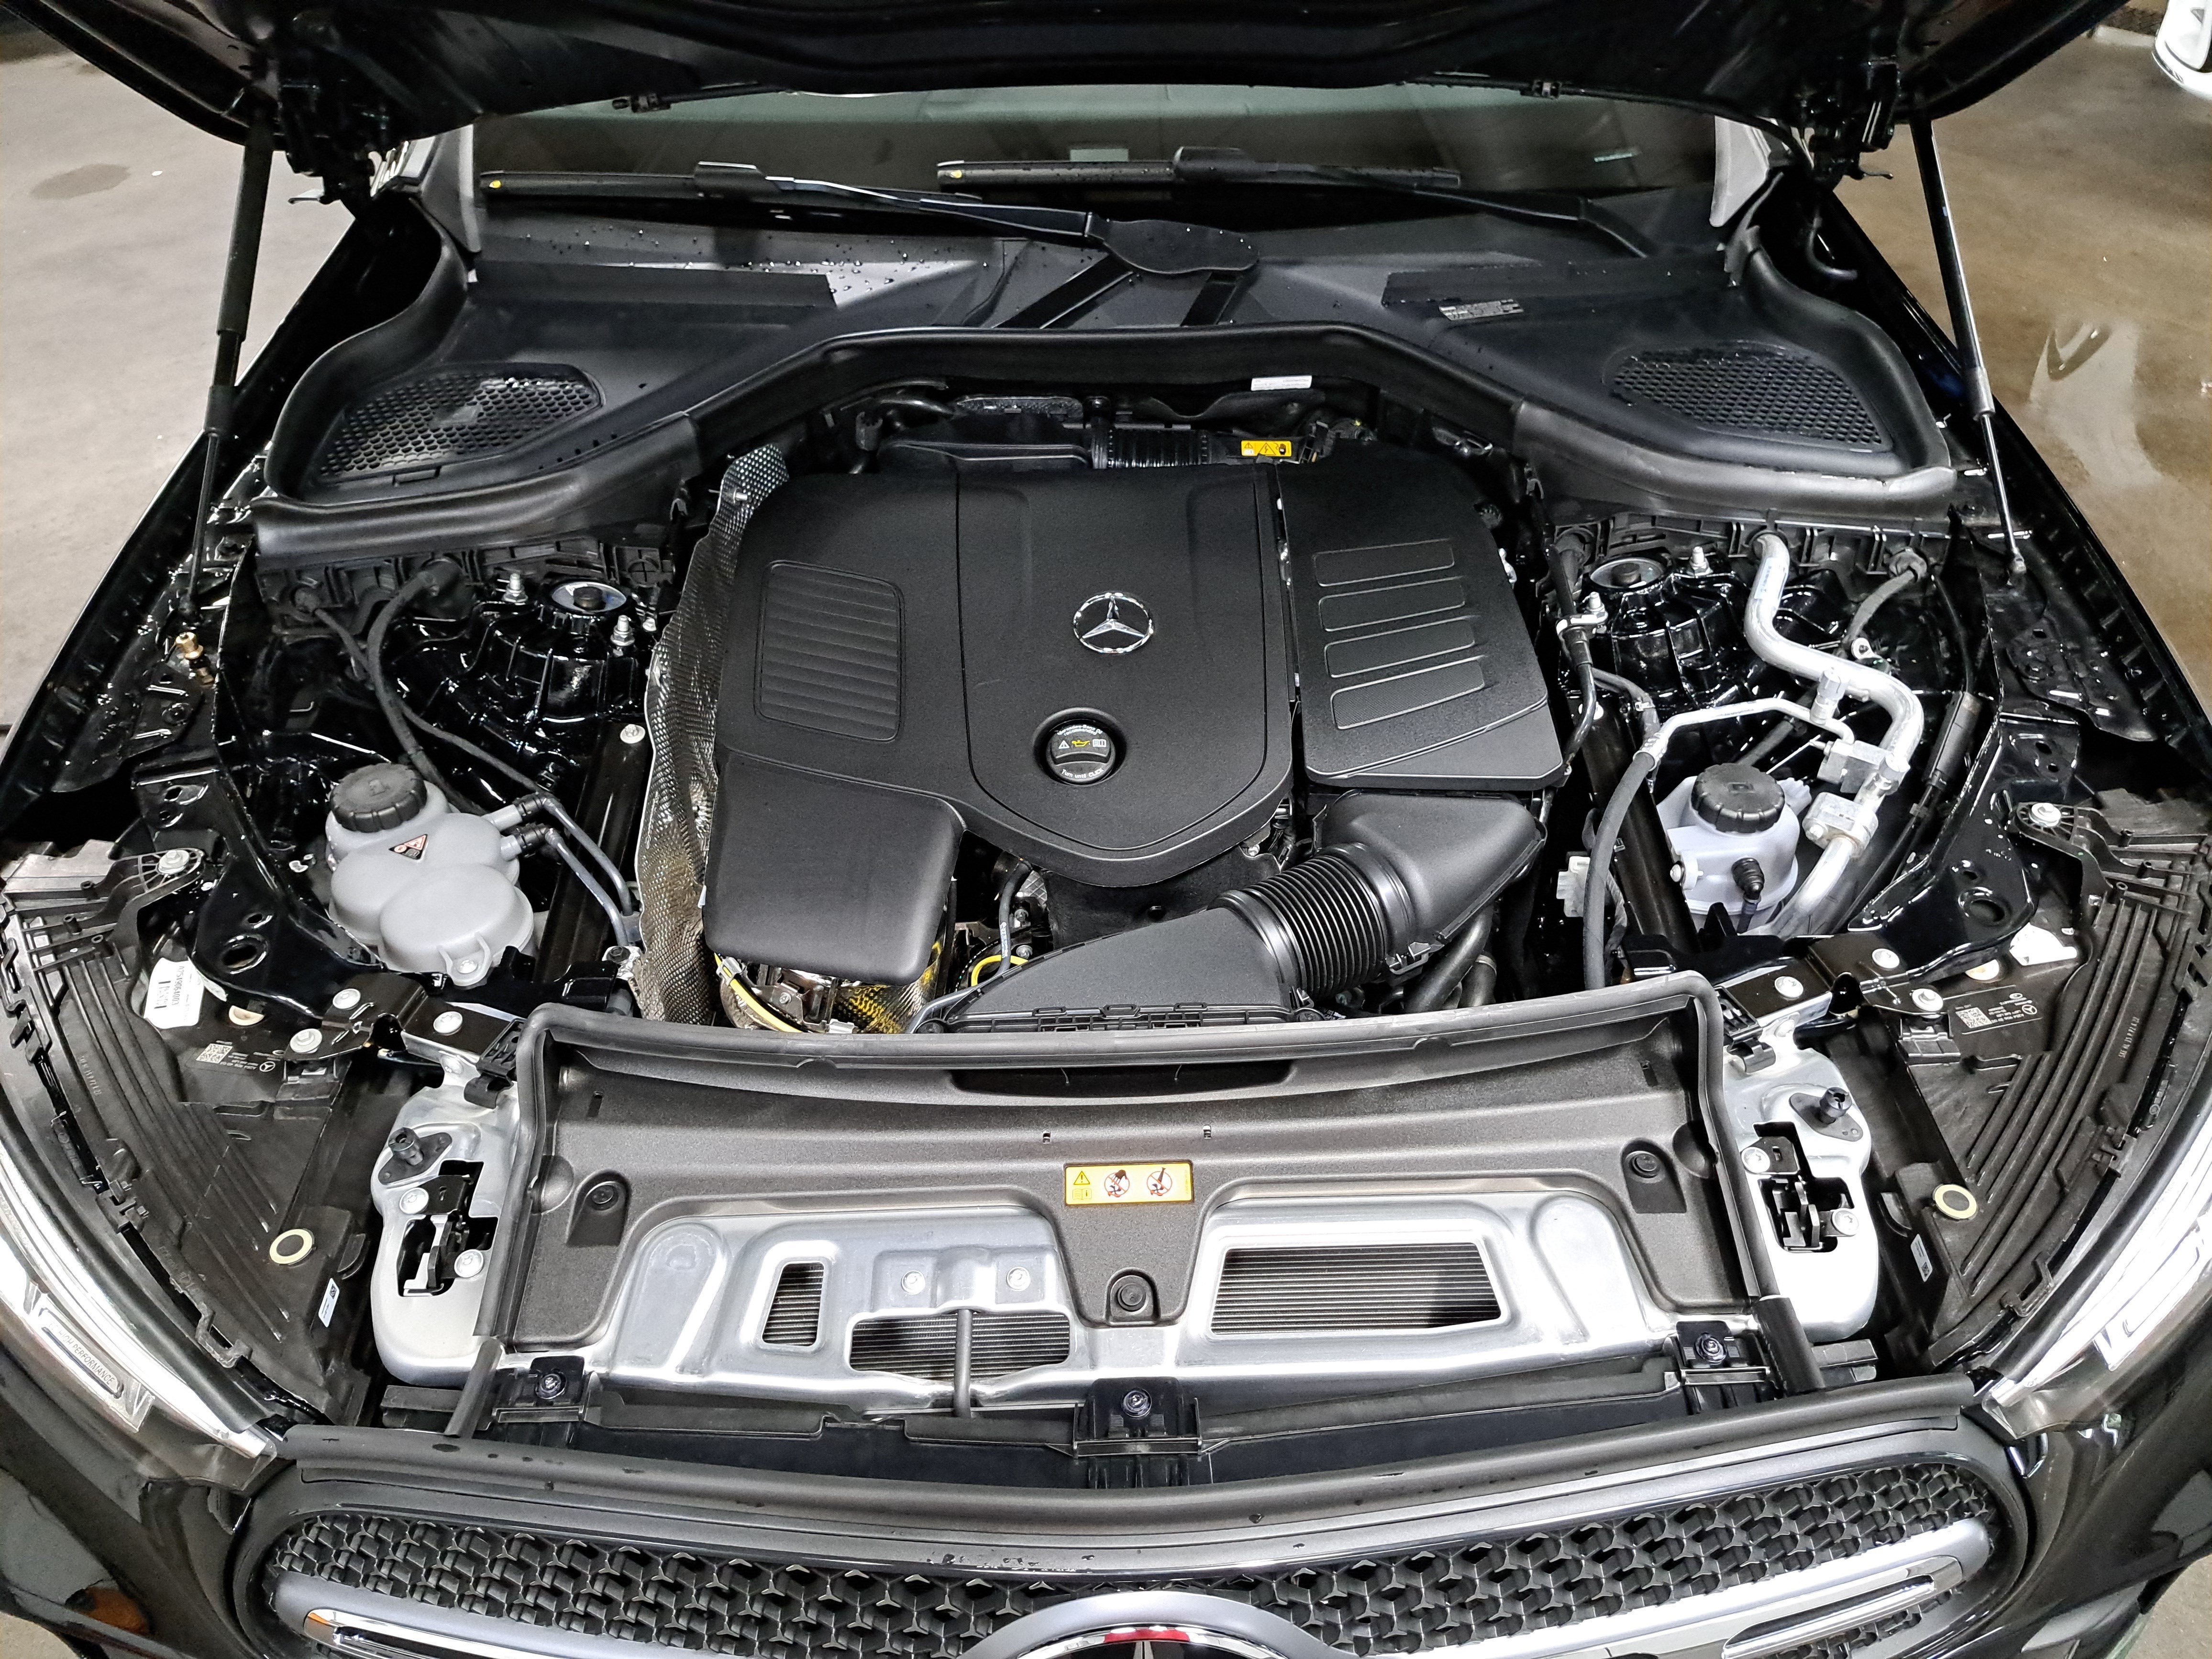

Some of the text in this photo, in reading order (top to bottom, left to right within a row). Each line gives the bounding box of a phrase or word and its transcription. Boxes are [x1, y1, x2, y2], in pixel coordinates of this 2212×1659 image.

[1062, 769, 1073, 777] Turn
[1088, 767, 1104, 777] CLICK
[72, 1343, 115, 1385] PERFORMANCE
